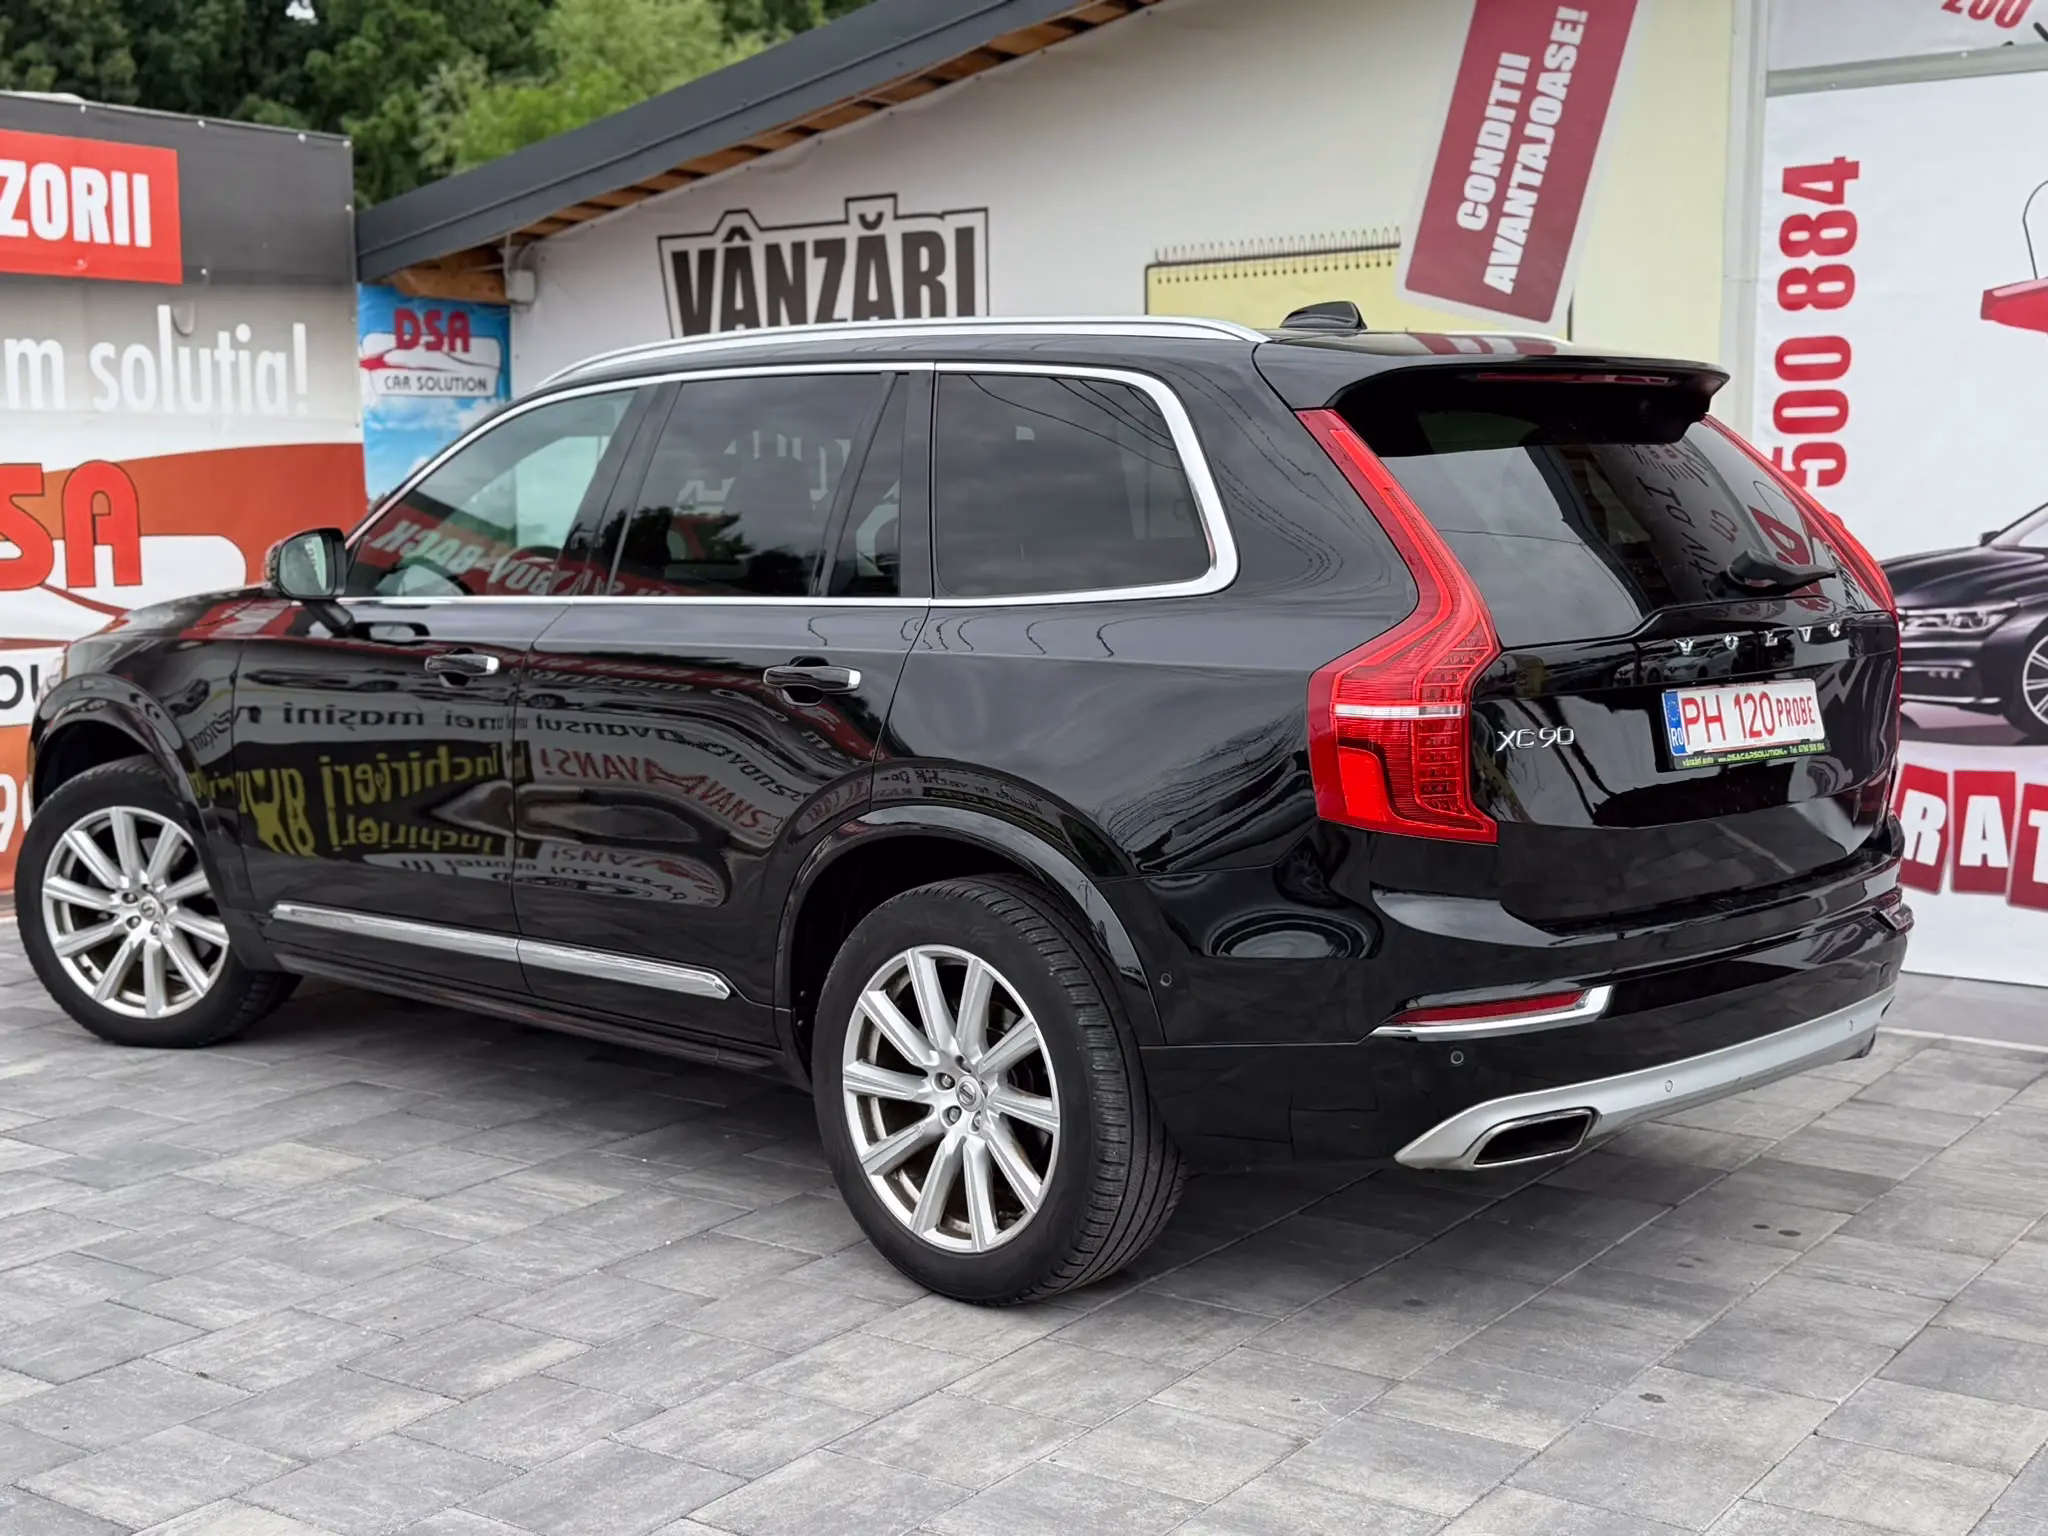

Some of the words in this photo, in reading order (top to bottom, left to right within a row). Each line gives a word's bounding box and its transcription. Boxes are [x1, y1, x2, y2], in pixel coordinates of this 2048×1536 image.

[1456, 52, 1531, 231] CONDITII
[1483, 5, 1589, 295] AVANTAJOASE!
[1777, 156, 1860, 312] 884
[671, 211, 976, 337] VÂNZĂRI
[394, 307, 470, 353] DSA
[384, 375, 411, 391] CAR
[416, 375, 488, 392] SOLUTION
[1772, 335, 1851, 488] 500
[1674, 622, 1842, 656] VOLVO
[1496, 726, 1575, 752] XC90
[1671, 727, 1684, 747] RO
[1681, 694, 1727, 746] PH
[1733, 691, 1777, 740] 120
[1776, 696, 1816, 728] PROBE
